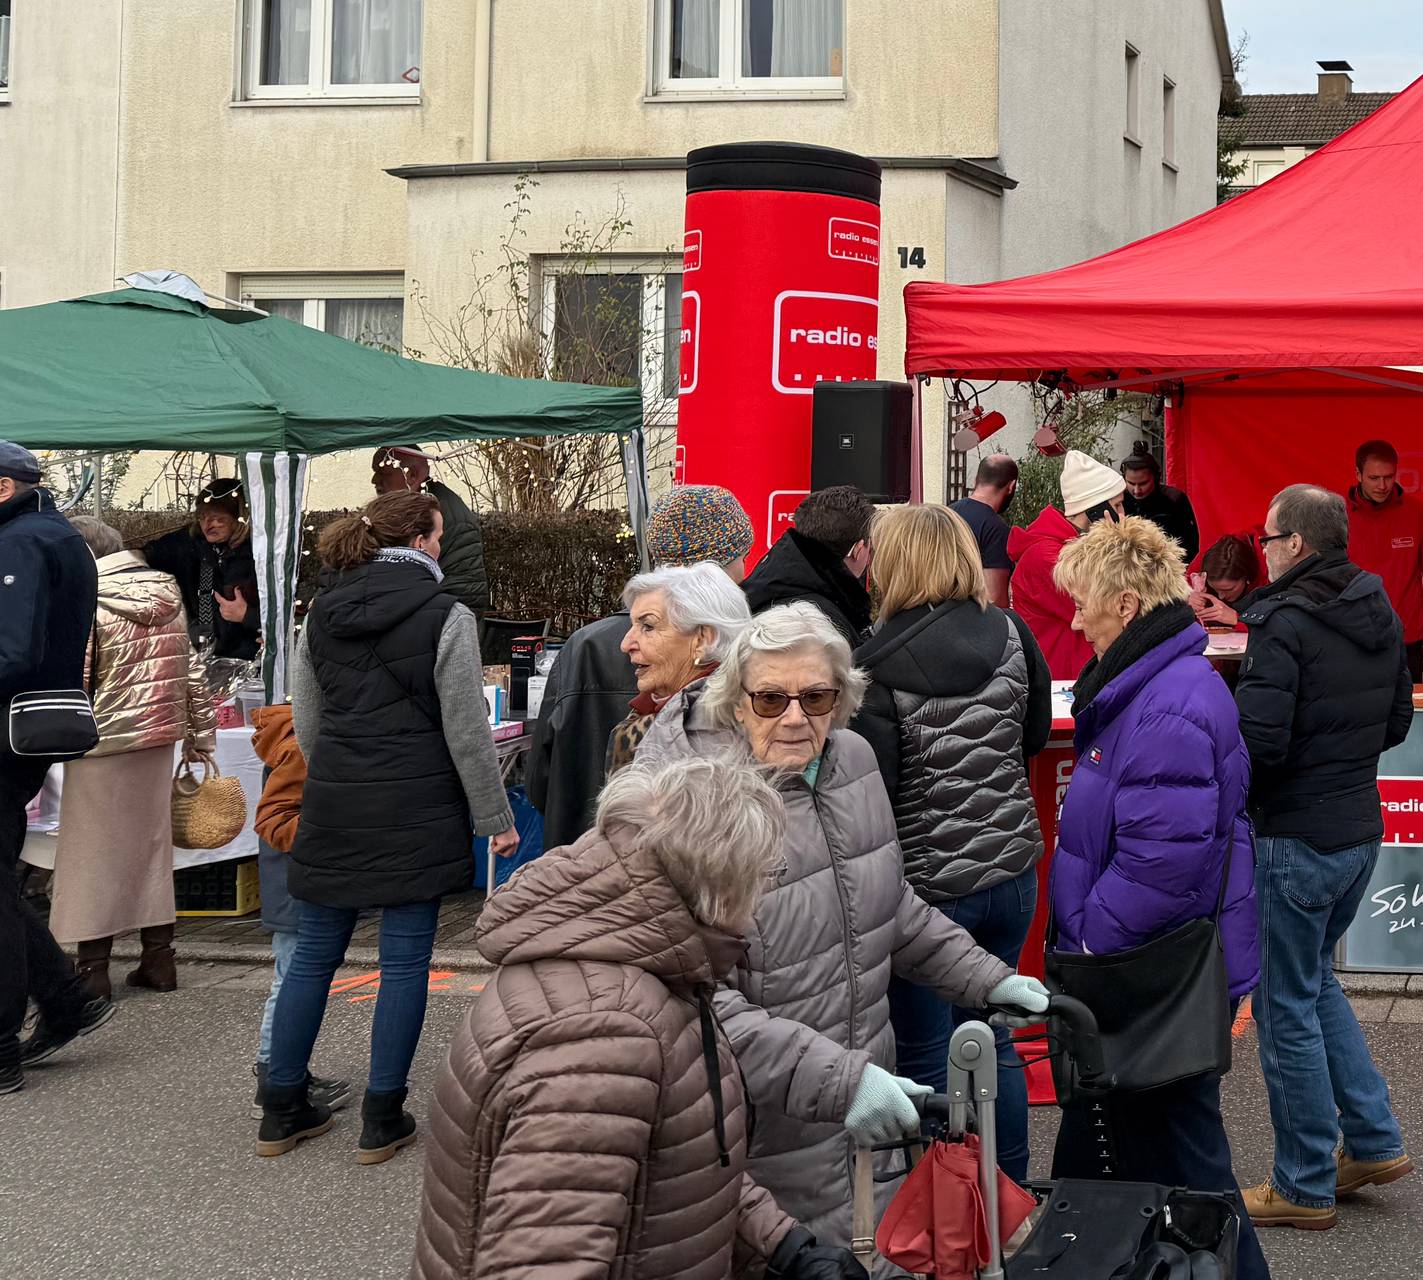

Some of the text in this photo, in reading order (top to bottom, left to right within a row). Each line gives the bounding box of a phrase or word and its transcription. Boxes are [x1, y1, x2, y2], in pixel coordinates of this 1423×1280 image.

[834, 232, 860, 241] radio
[897, 246, 926, 268] 14
[790, 327, 862, 347] radio
[1370, 883, 1407, 918] So
[1388, 917, 1416, 933] zu
